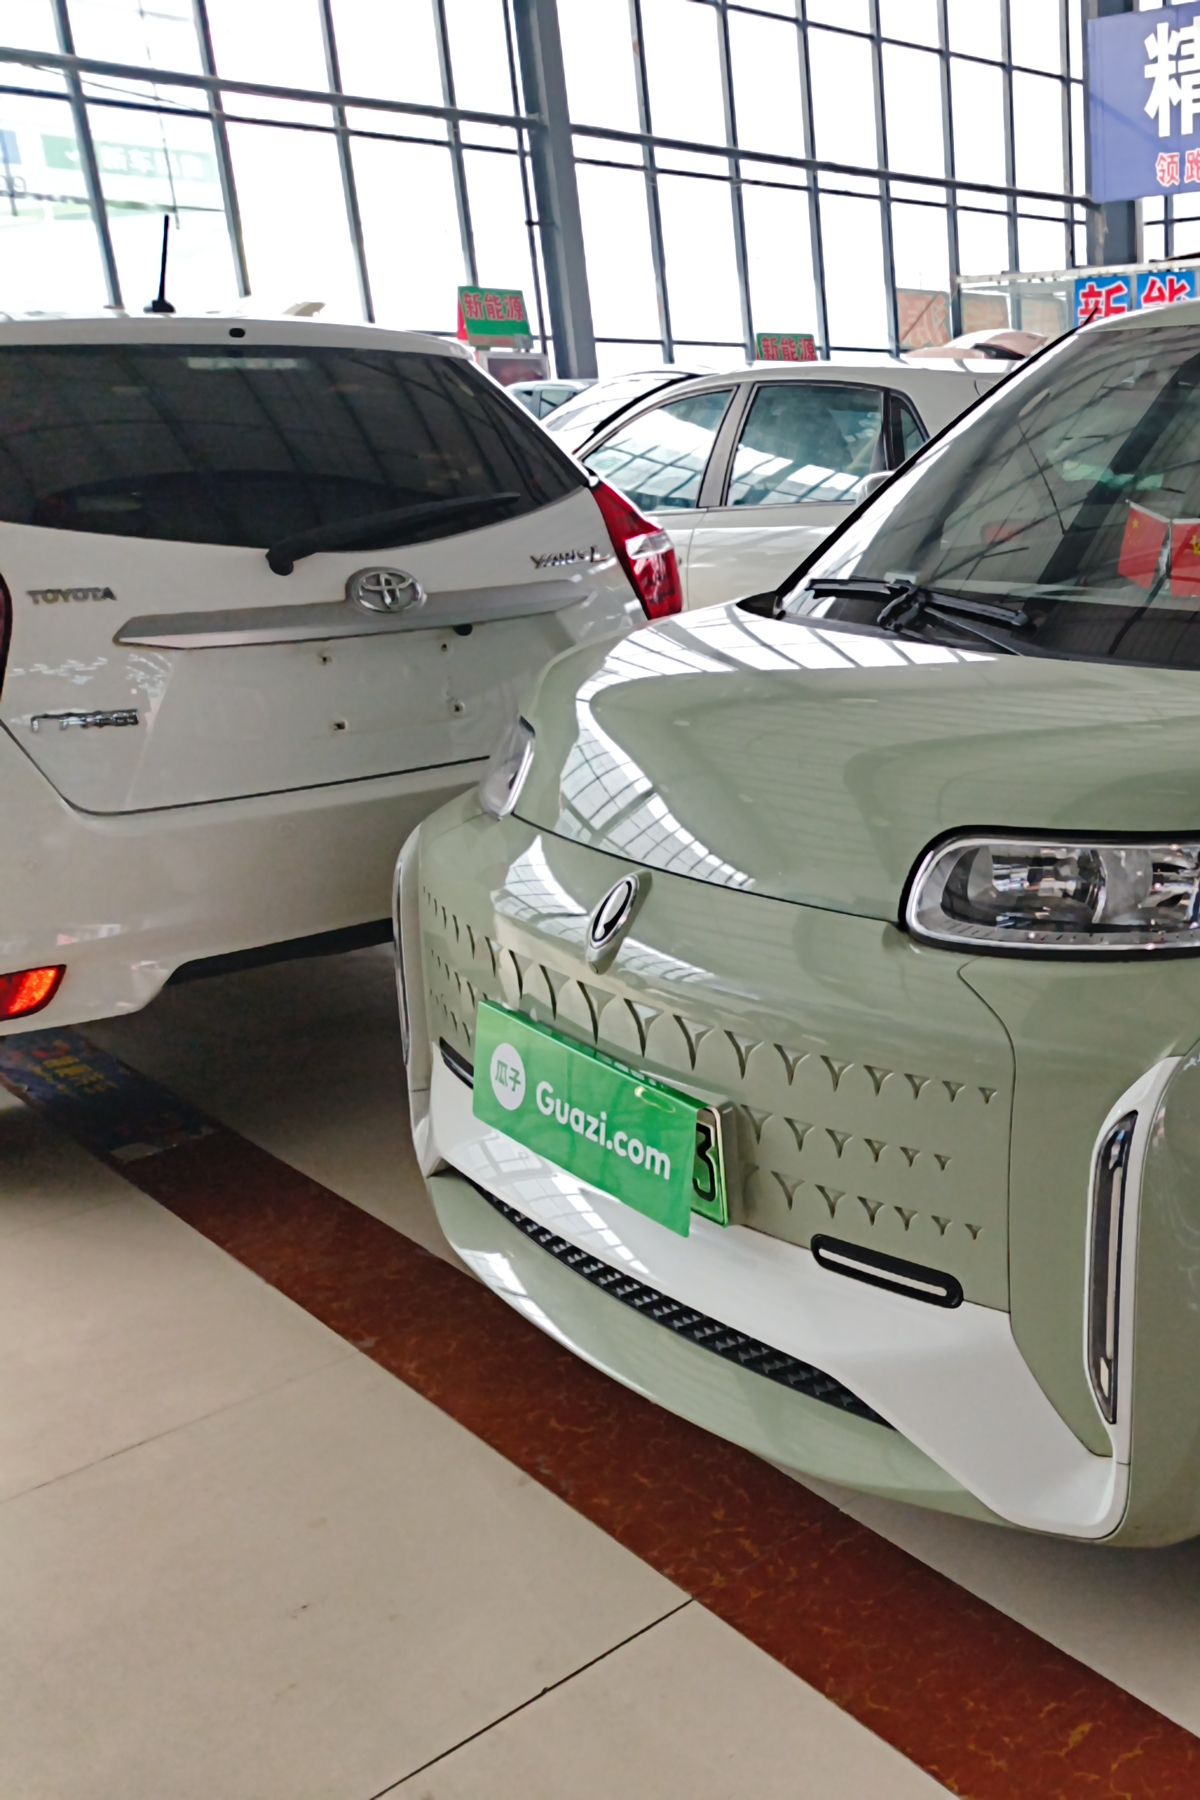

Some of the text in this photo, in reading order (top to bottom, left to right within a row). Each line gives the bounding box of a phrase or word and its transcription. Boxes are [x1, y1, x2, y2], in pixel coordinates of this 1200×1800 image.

[463, 292, 525, 322] 新能源
[26, 586, 118, 605] TOYOTA
[495, 1059, 522, 1093] 瓜子
[535, 1081, 672, 1181] Guazi.com
